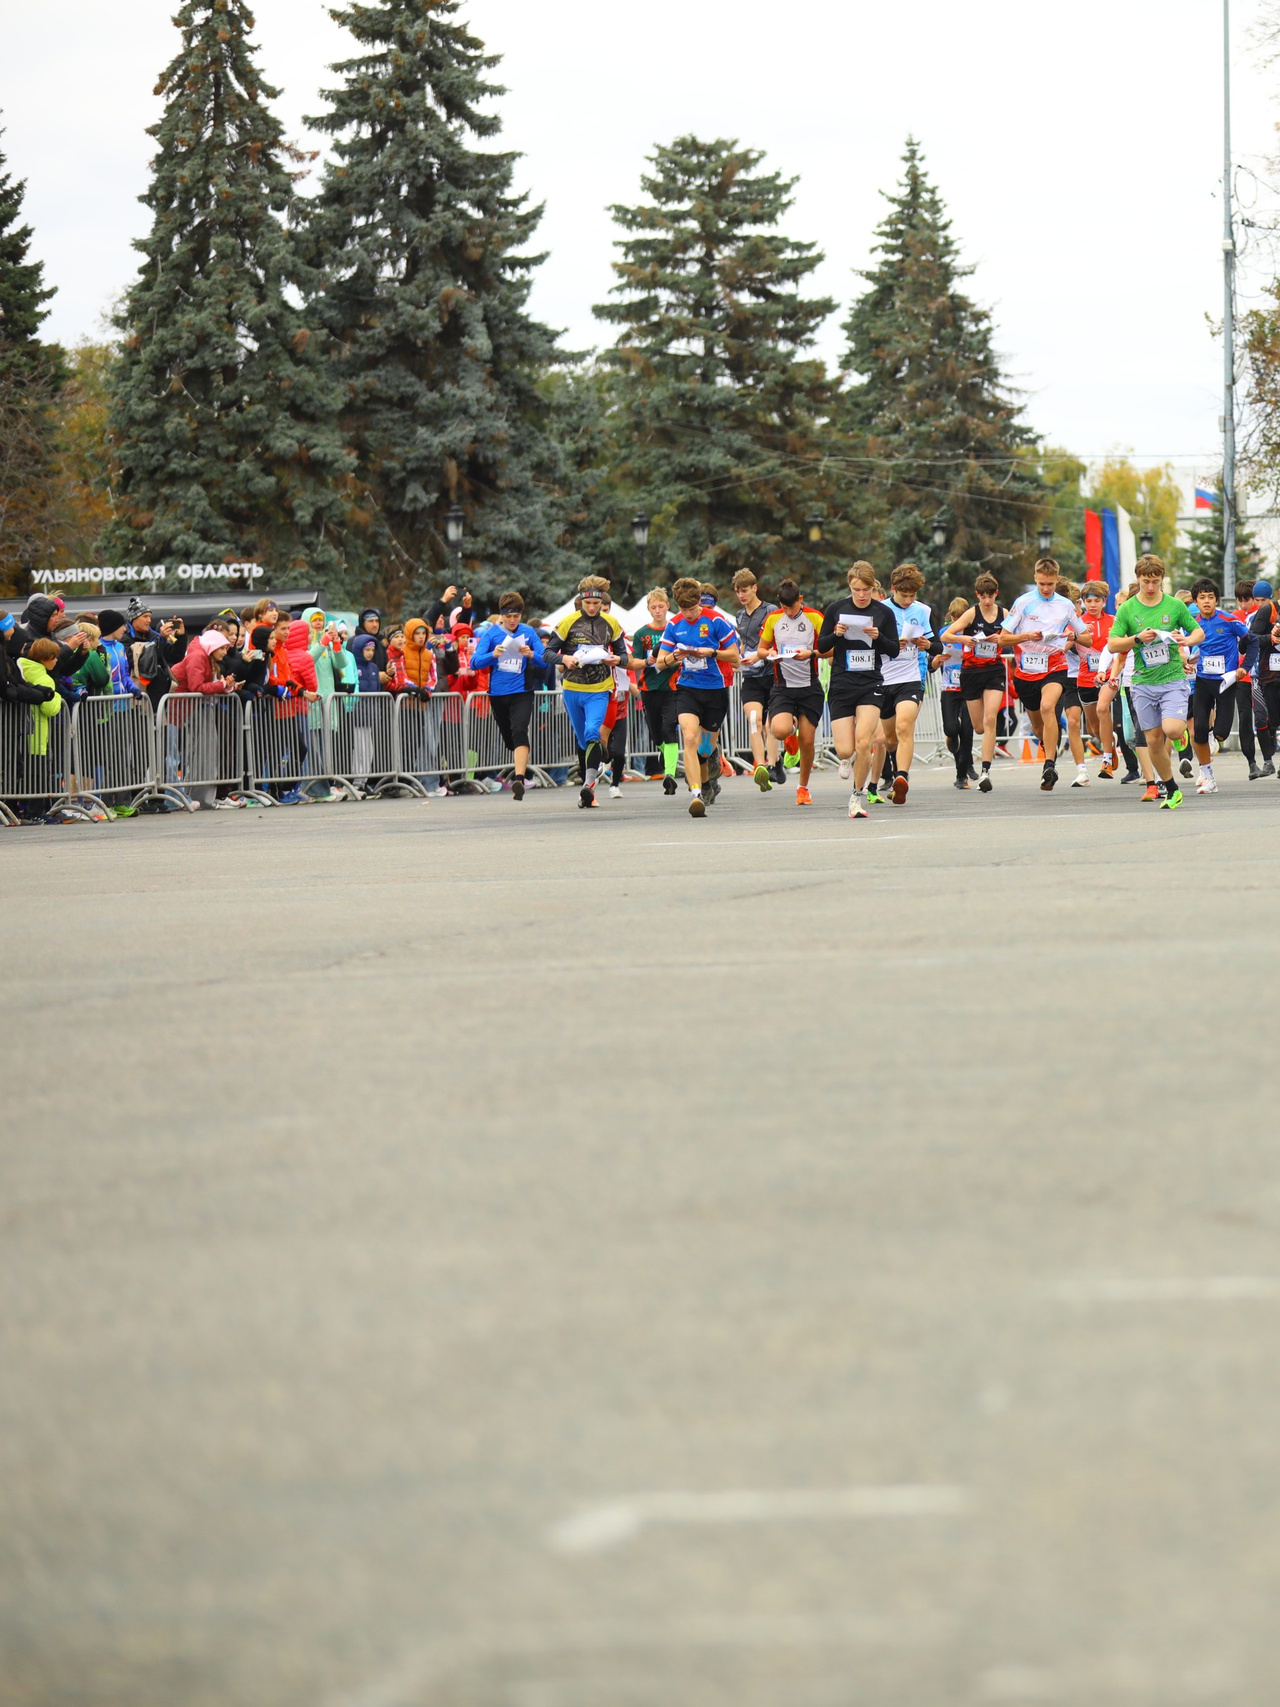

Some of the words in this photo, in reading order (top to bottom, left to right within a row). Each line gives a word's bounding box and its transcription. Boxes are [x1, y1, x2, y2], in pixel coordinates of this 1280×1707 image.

[31, 564, 166, 584] УЛЬЯНОВСКАЯ
[178, 562, 264, 579] ОБЛАСТЬ
[979, 643, 995, 652] 347.1
[1145, 648, 1165, 660] 312.1
[850, 655, 871, 663] 308.1
[1025, 656, 1044, 665] 327.1
